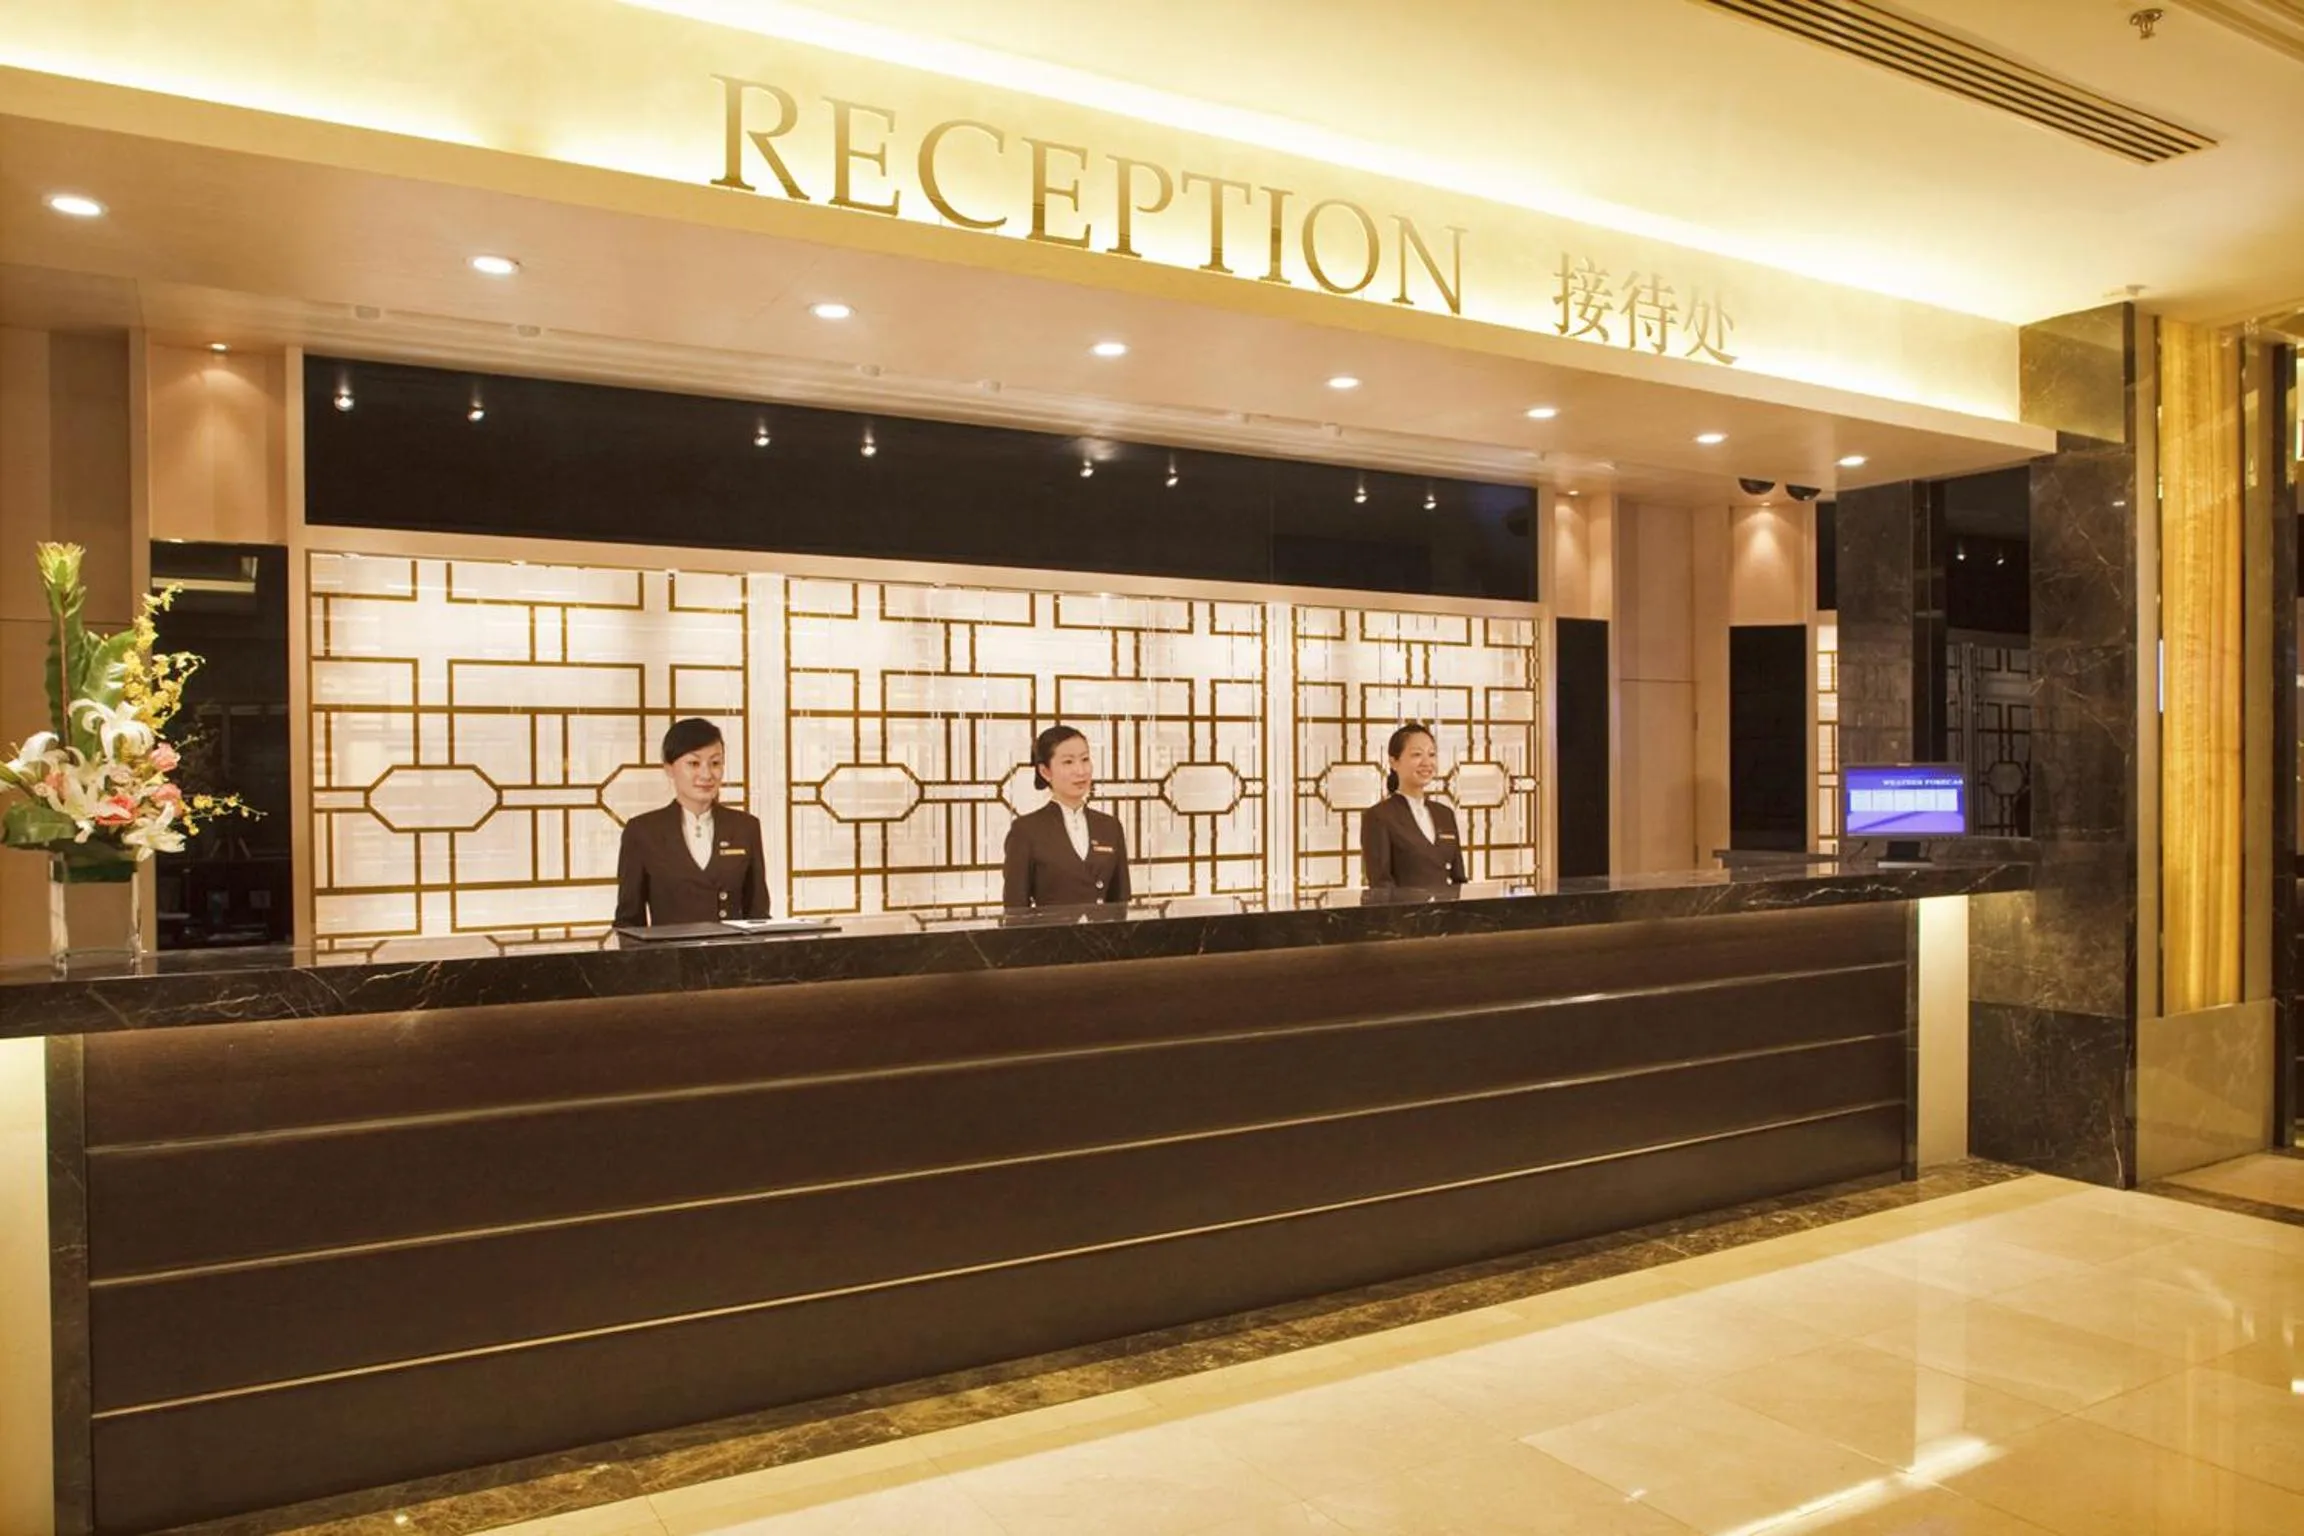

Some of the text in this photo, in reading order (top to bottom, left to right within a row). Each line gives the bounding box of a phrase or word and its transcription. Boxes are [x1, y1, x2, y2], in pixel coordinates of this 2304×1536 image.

[709, 73, 1469, 316] RECEPTION
[1552, 251, 1739, 366] 接待处
